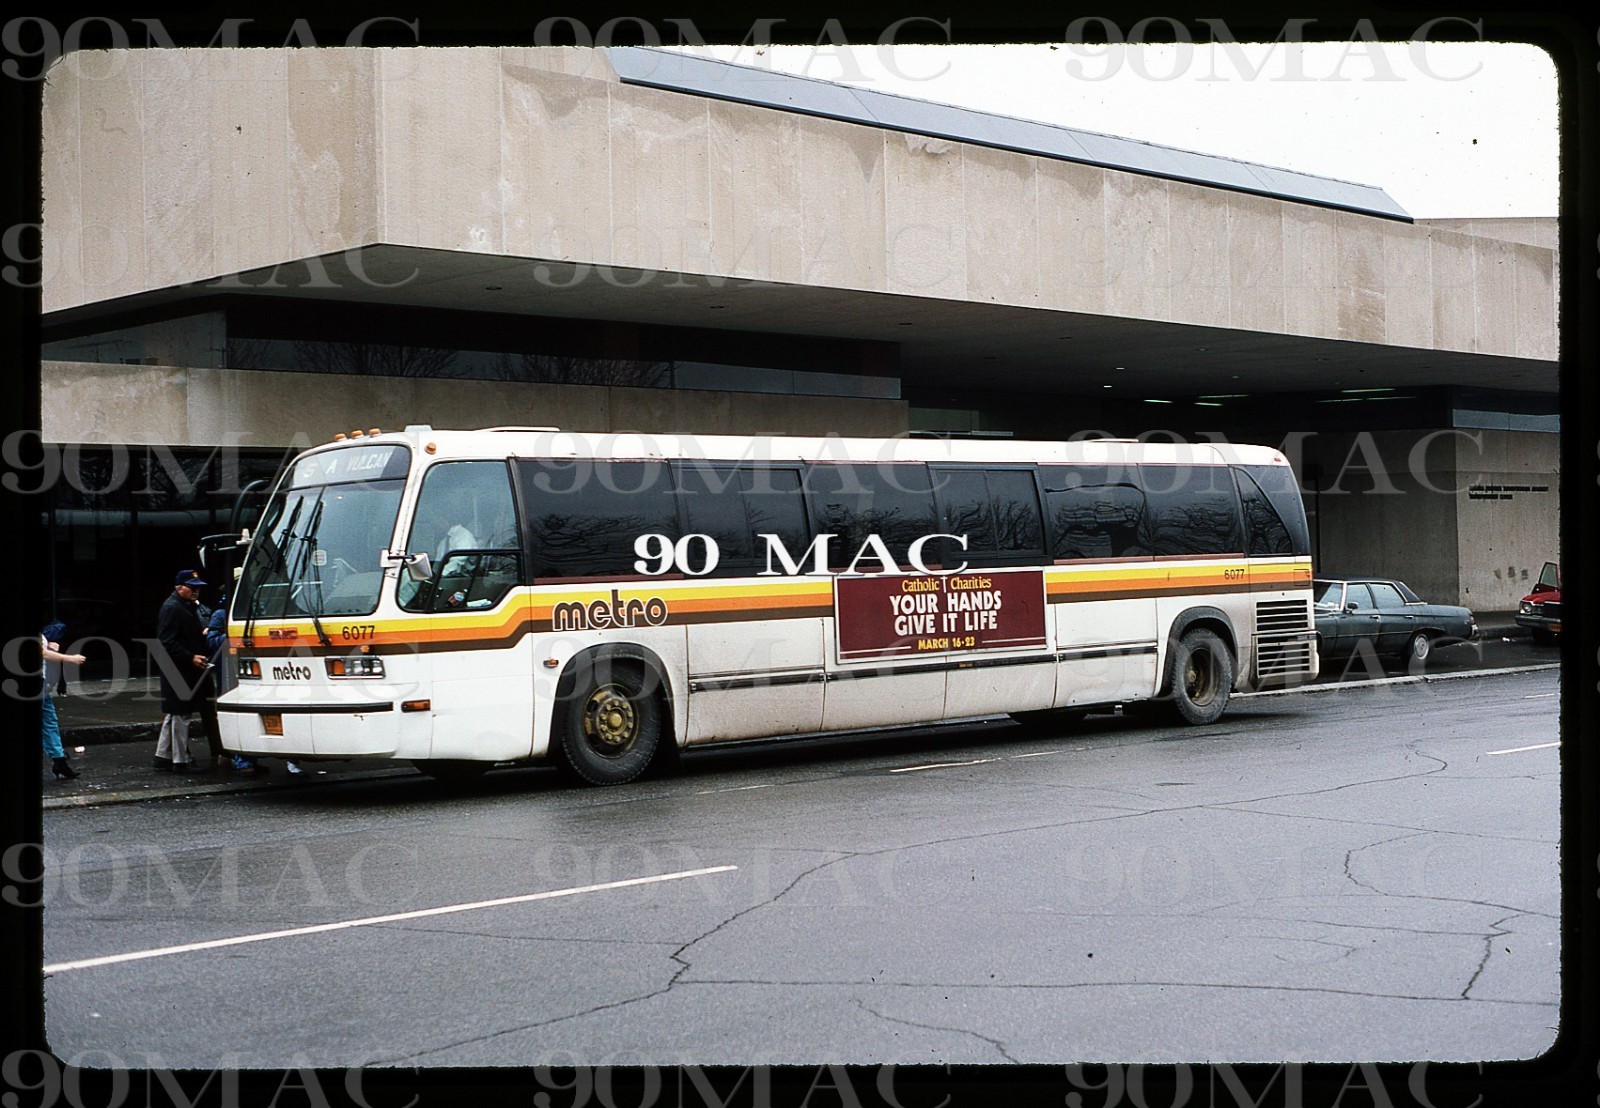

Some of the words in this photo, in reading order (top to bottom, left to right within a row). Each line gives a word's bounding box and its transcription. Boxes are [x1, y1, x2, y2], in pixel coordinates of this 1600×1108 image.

[325, 459, 337, 474] A
[1224, 568, 1245, 580] 6077
[901, 578, 940, 592] Catholic
[950, 576, 992, 589] Charities
[552, 589, 669, 632] metro
[889, 593, 939, 615] YOUR
[947, 591, 1002, 611] HANDS
[894, 614, 936, 636] GIVE
[943, 613, 958, 632] IT
[964, 611, 998, 631] LIFE
[342, 625, 375, 640] 6077
[918, 638, 949, 650] MARCH
[273, 661, 311, 681] metro
